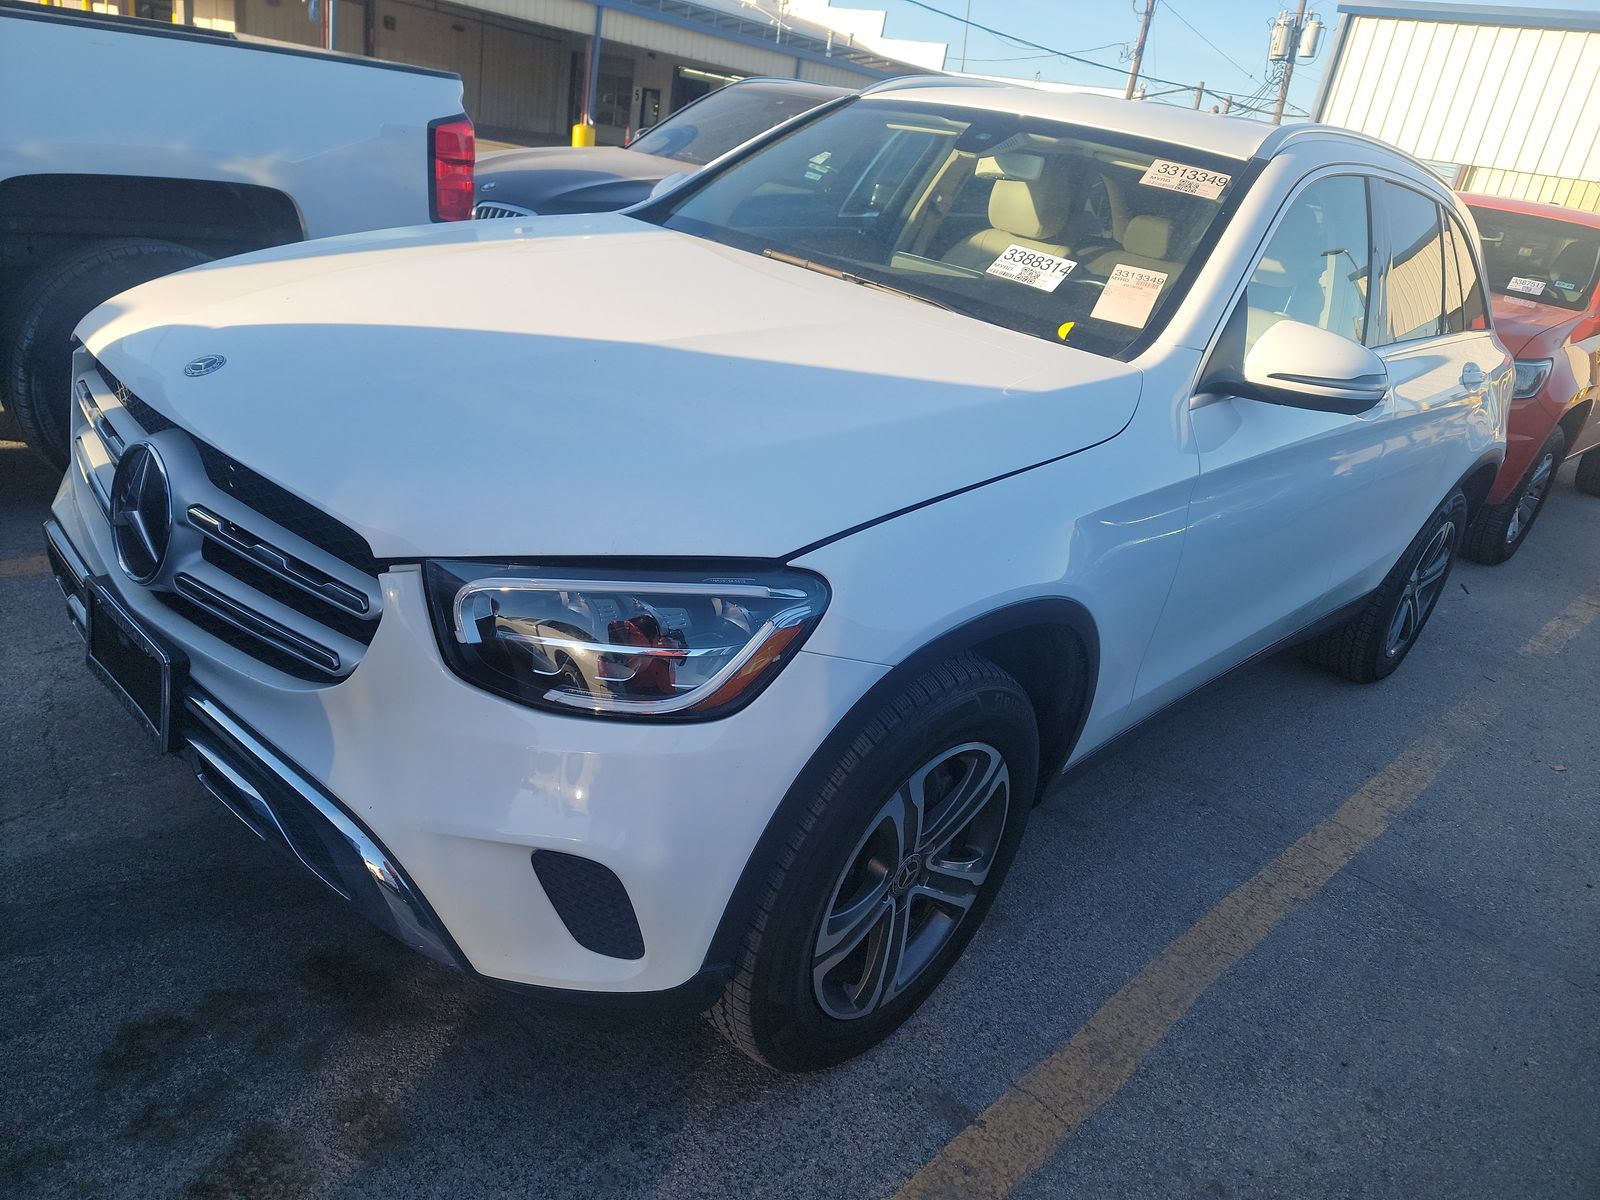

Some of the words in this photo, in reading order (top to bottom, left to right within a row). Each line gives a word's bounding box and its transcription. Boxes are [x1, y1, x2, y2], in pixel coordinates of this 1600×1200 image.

[634, 90, 640, 102] 5
[1157, 163, 1228, 187] 3313349
[1003, 248, 1072, 277] 3388314
[1114, 269, 1165, 285] 3313349
[1511, 278, 1546, 289] 3387517
